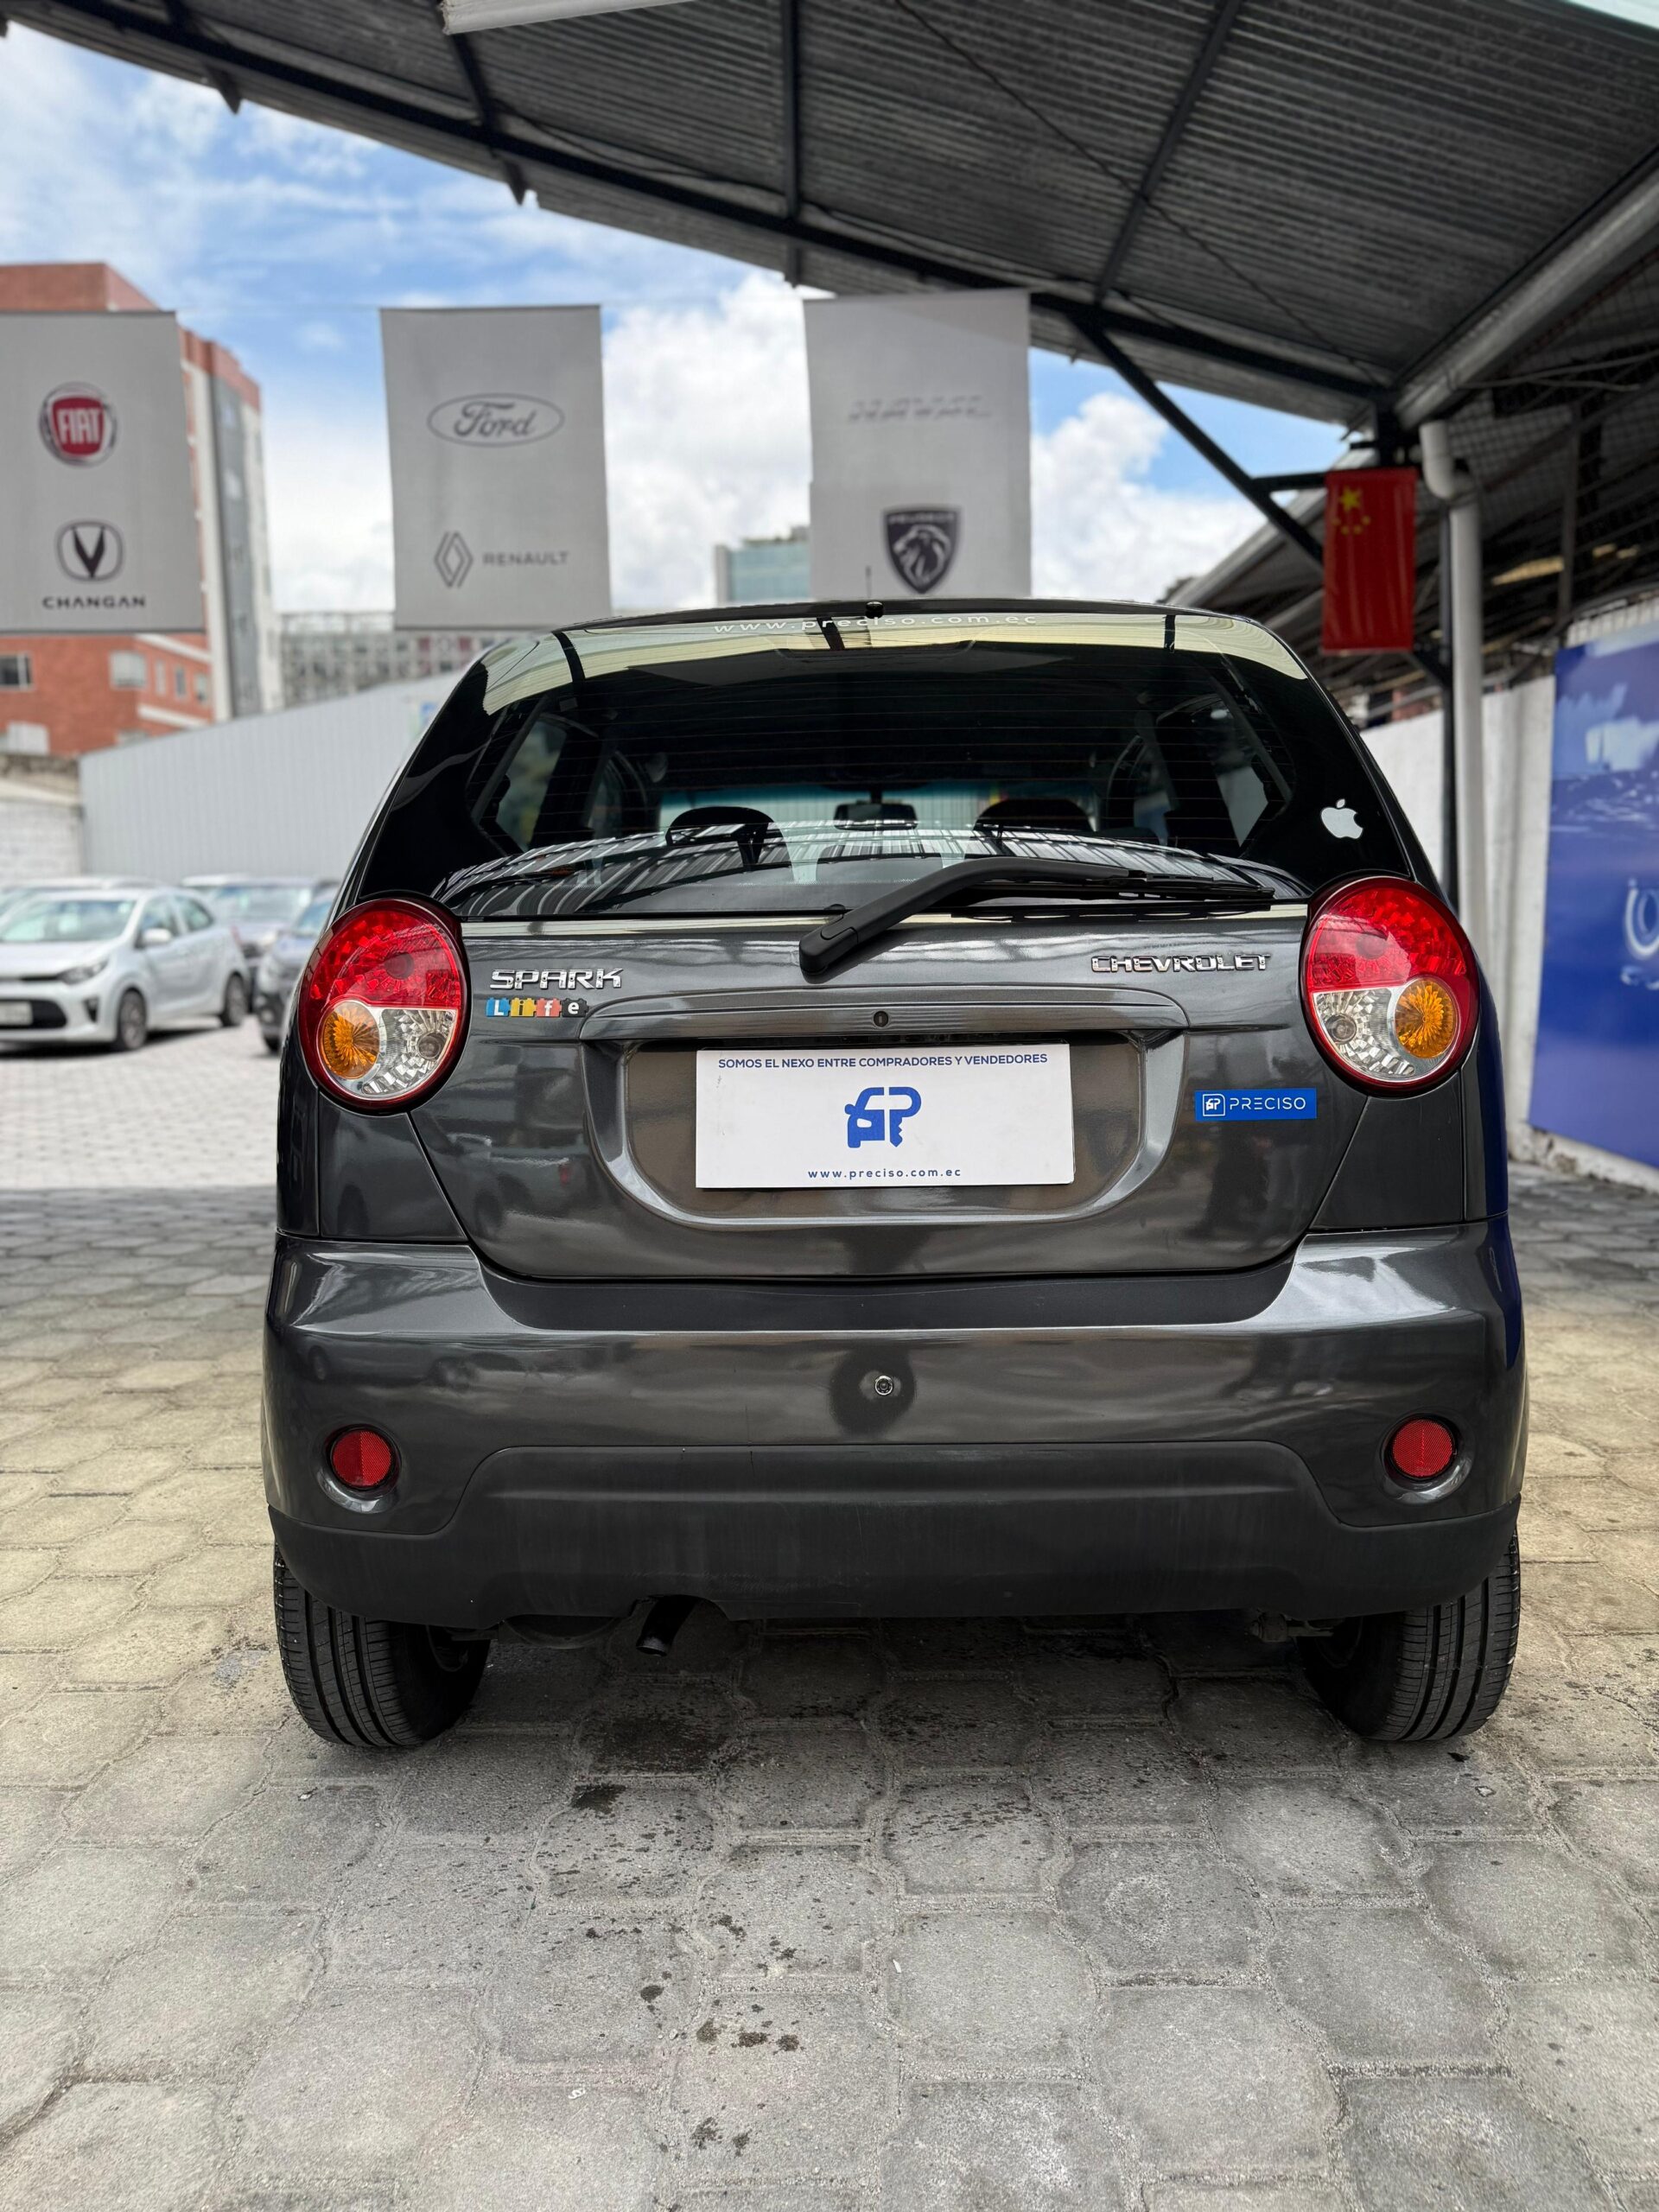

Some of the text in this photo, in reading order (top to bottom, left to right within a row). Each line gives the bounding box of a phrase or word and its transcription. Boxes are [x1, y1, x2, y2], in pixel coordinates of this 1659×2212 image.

[55, 407, 100, 444] FIAT
[454, 401, 537, 437] Ford
[482, 551, 569, 566] RENAULT
[42, 597, 146, 609] CHANGAN
[714, 613, 1037, 633] www.preciso.com.ec
[1091, 954, 1271, 972] CHEVROLET
[489, 968, 624, 989] SPARK
[493, 1000, 580, 1016] Life
[718, 1053, 1048, 1068] SOMOS EL NEXO ENTRE COMPRADORES Y VENDEDORES
[1229, 1096, 1307, 1111] PRECISO
[808, 1168, 961, 1180] www.preciso.com.ec
